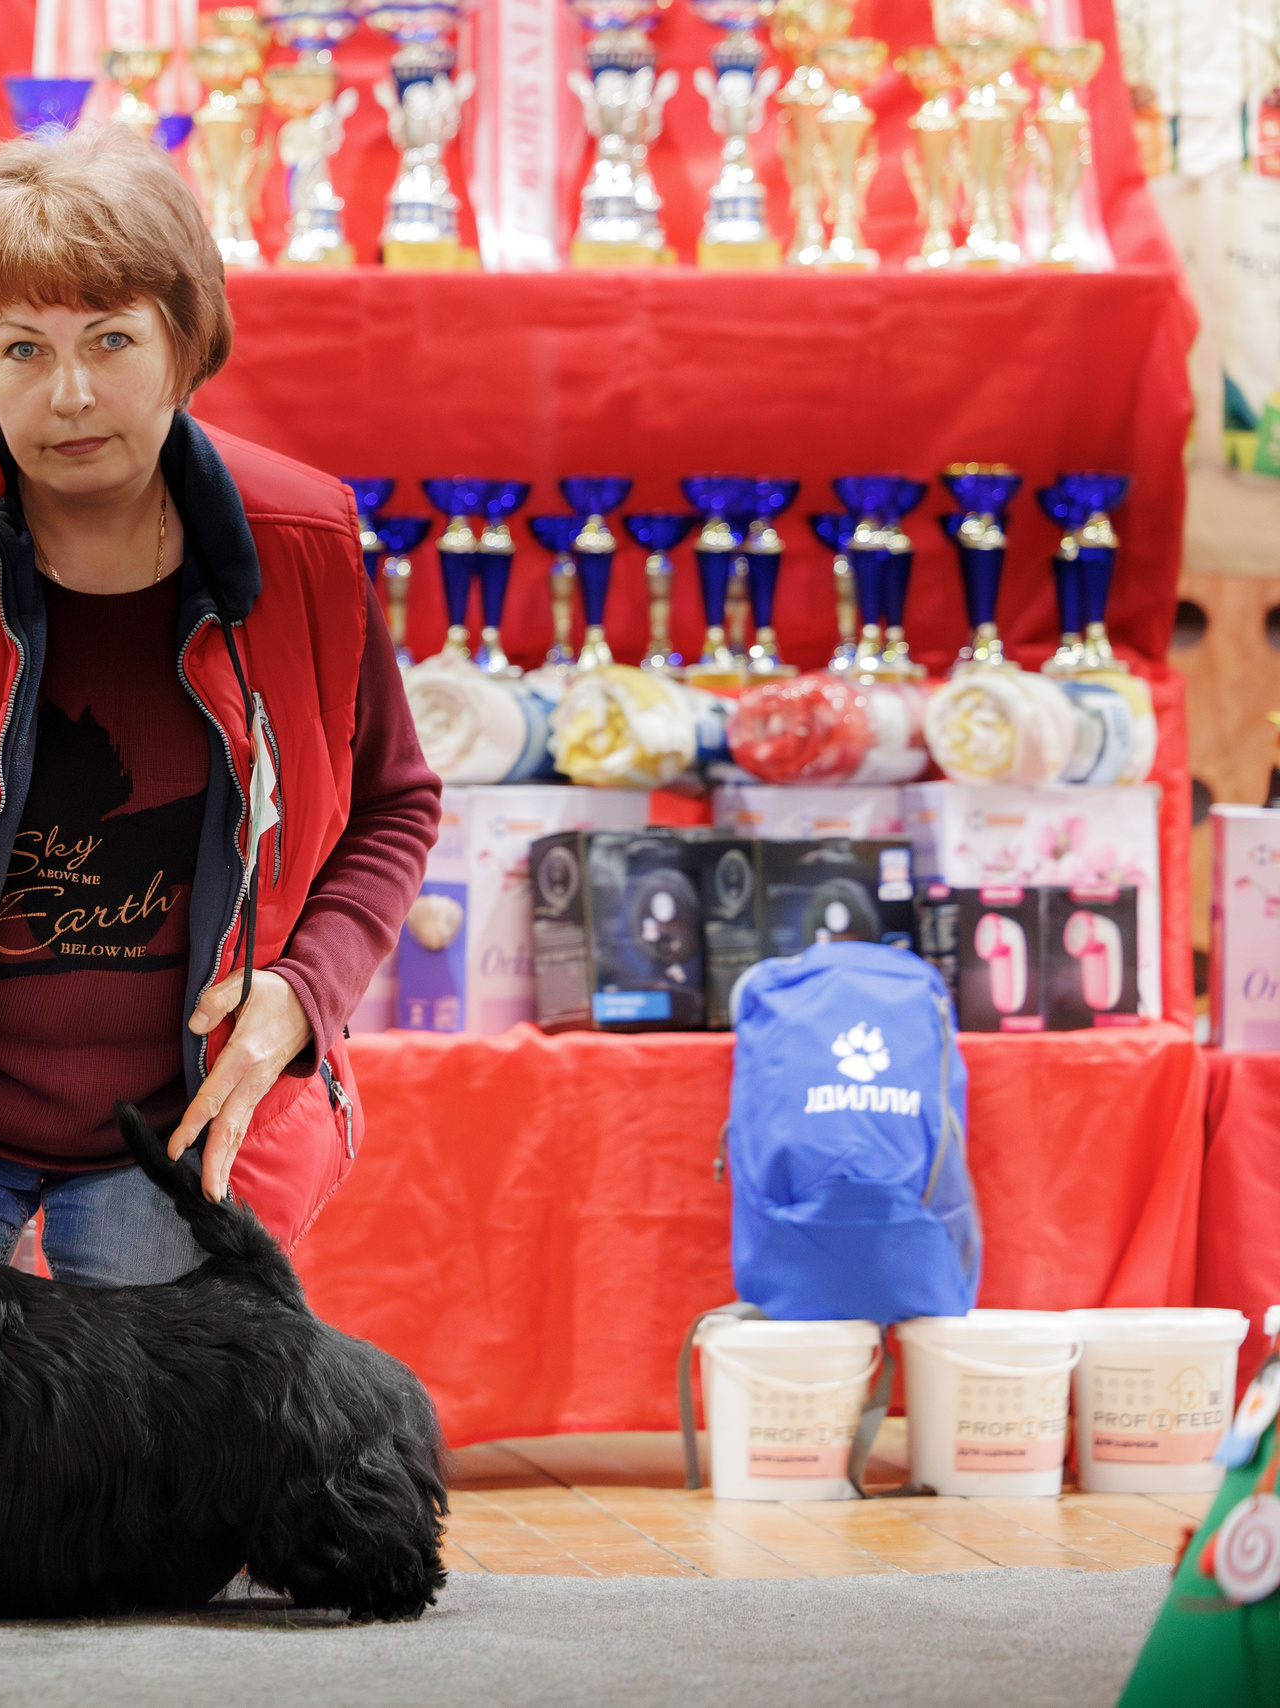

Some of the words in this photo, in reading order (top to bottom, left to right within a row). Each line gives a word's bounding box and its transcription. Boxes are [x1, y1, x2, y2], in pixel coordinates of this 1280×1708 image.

[6, 825, 103, 876] Sky
[37, 868, 79, 884] ABOVE
[81, 873, 101, 886] ME
[60, 943, 122, 957] BELOW
[123, 946, 147, 958] ME
